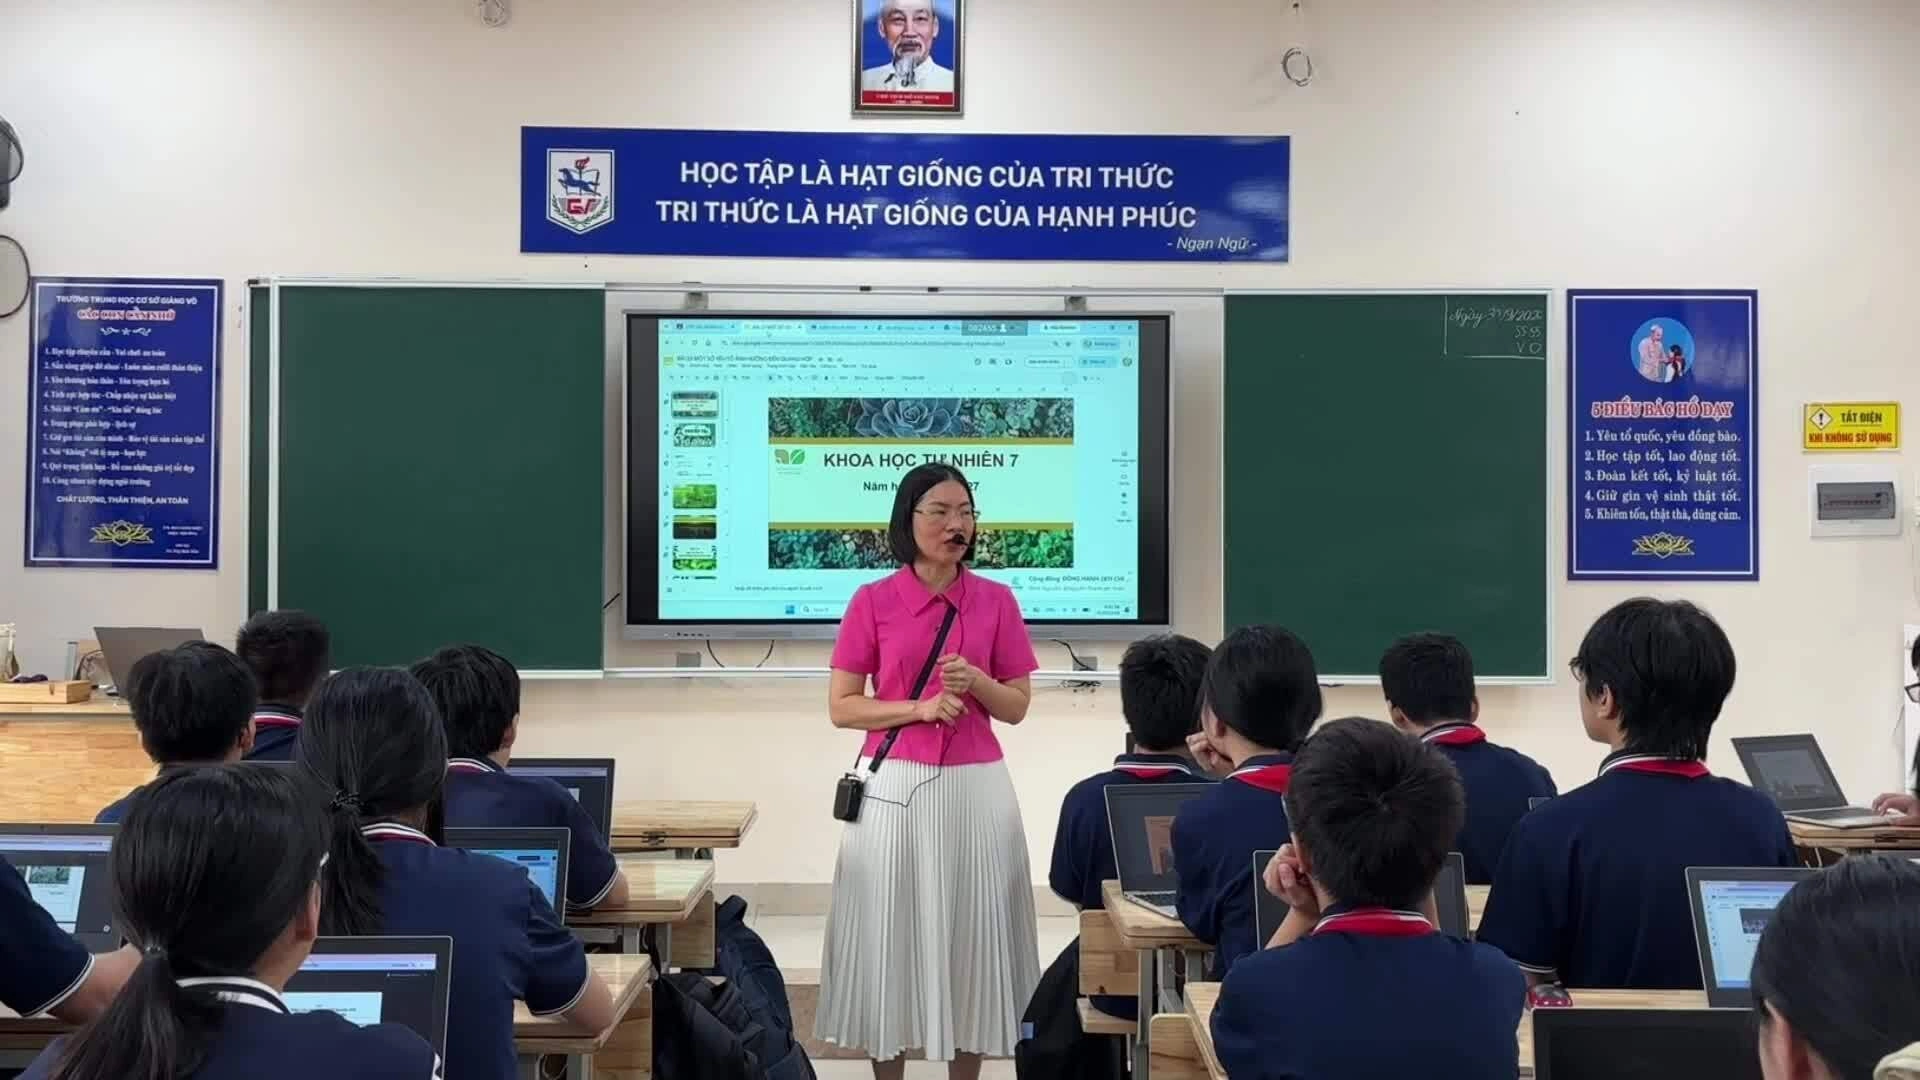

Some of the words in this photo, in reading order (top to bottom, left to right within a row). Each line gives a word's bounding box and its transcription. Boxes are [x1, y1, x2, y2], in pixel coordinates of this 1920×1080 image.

[680, 161, 738, 189] HỌC
[744, 158, 794, 190] TẬP
[801, 159, 834, 185] LÀ
[840, 164, 892, 191] HẠT
[898, 158, 982, 187] GIỐNG
[989, 160, 1045, 188] CỦA
[1050, 166, 1091, 188] TRI
[1098, 162, 1174, 189] THỨC
[656, 200, 697, 222] TRI
[704, 197, 779, 224] THỨC
[787, 198, 819, 224] LÀ
[826, 203, 878, 230] HẠT
[884, 197, 968, 227] GIỐNG
[975, 199, 1031, 227] CỦA
[1037, 205, 1114, 232] HẠNH
[1122, 201, 1196, 228] PHÚC
[1176, 237, 1215, 251] Ngạn
[56, 295, 89, 304] TRƯỜNG
[91, 296, 116, 304] TRUNG
[118, 296, 135, 305] HỌC
[1591, 401, 1601, 418] 5
[1602, 394, 1642, 418] ĐIỀU
[1642, 397, 1675, 418] BÁC
[1675, 394, 1701, 419] HỒ
[1700, 401, 1734, 422] DẠY
[1585, 430, 1595, 442] 1.
[1596, 429, 1618, 442] Yêu
[1633, 427, 1664, 444] quốc,
[1665, 430, 1685, 444] yêu
[1688, 428, 1715, 444] đồng
[1717, 430, 1741, 441] bào.
[1808, 432, 1823, 442] KHI
[1825, 430, 1854, 442] KHÔNG
[1869, 432, 1892, 444] DỤNG
[823, 453, 874, 468] KHOA
[879, 453, 917, 471] HỌC
[952, 450, 1004, 468] NHIÊN
[1010, 454, 1019, 468] 7
[1584, 449, 1595, 462] 2.
[1596, 449, 1619, 464] Học
[1623, 448, 1641, 464] tập
[1645, 448, 1665, 464] tốt,
[1668, 449, 1686, 462] lao
[1689, 449, 1718, 464] động
[1721, 447, 1742, 462] tốt.
[1584, 470, 1595, 481] 3.
[1596, 469, 1626, 481] Đoàn
[1631, 468, 1649, 481] kết
[1653, 468, 1672, 484] tốt,
[1695, 470, 1717, 484] luật
[1721, 468, 1742, 481] tốt.
[863, 481, 888, 491] Năm
[56, 493, 78, 503] CHẤT
[1584, 489, 1595, 501] 4.
[1596, 489, 1618, 501] Giữ
[1622, 489, 1640, 504] gìn
[1645, 489, 1659, 504] vệ
[1663, 489, 1688, 501] sinh
[1693, 489, 1716, 504] thật
[1721, 488, 1742, 501] tốt.
[1584, 508, 1595, 520] 5.
[1596, 507, 1628, 520] Khiêm
[1629, 506, 1649, 521] tốn,
[1650, 508, 1670, 523] thật
[1672, 508, 1691, 521] thà,
[1692, 508, 1717, 522] dũng
[1718, 507, 1742, 520] cảm.
